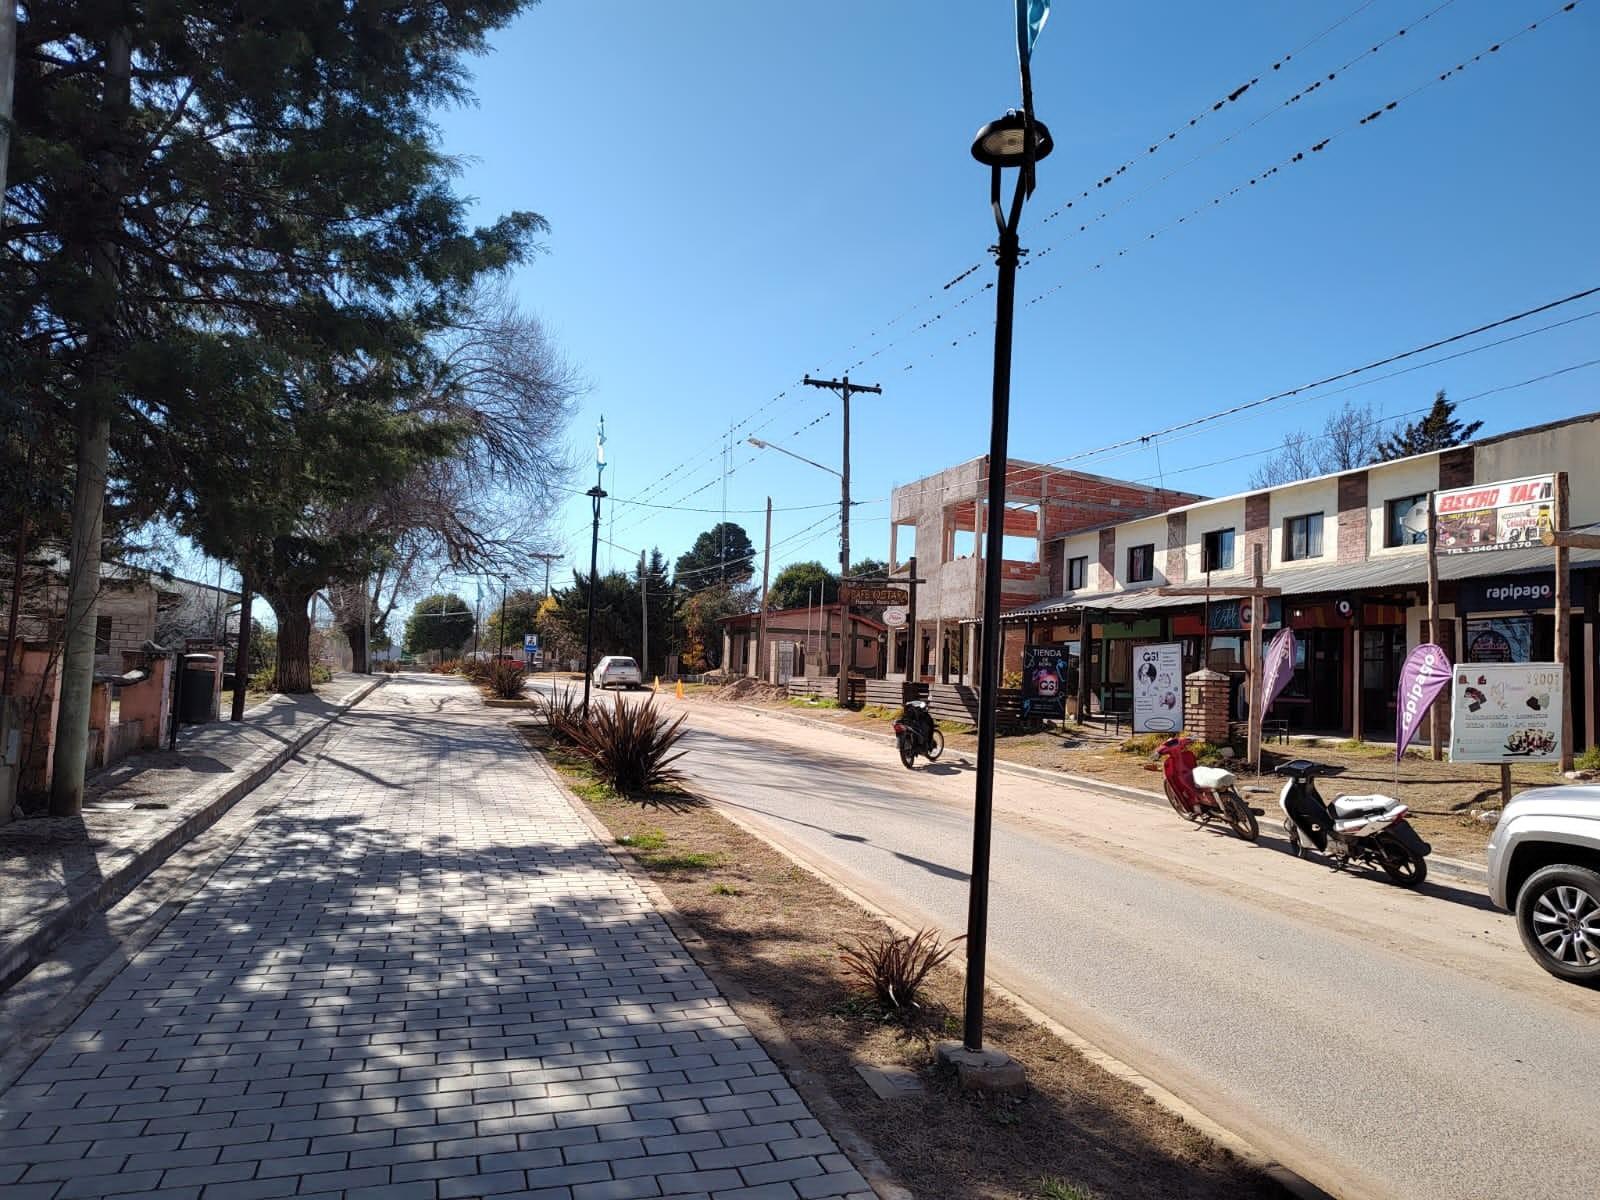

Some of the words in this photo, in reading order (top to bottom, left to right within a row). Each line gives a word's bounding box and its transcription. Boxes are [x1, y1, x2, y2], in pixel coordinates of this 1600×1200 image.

[1439, 489, 1500, 513] ELECTRO
[1486, 583, 1550, 600] rapipago
[1033, 648, 1062, 657] TIENDA
[1402, 653, 1435, 731] rapipago
